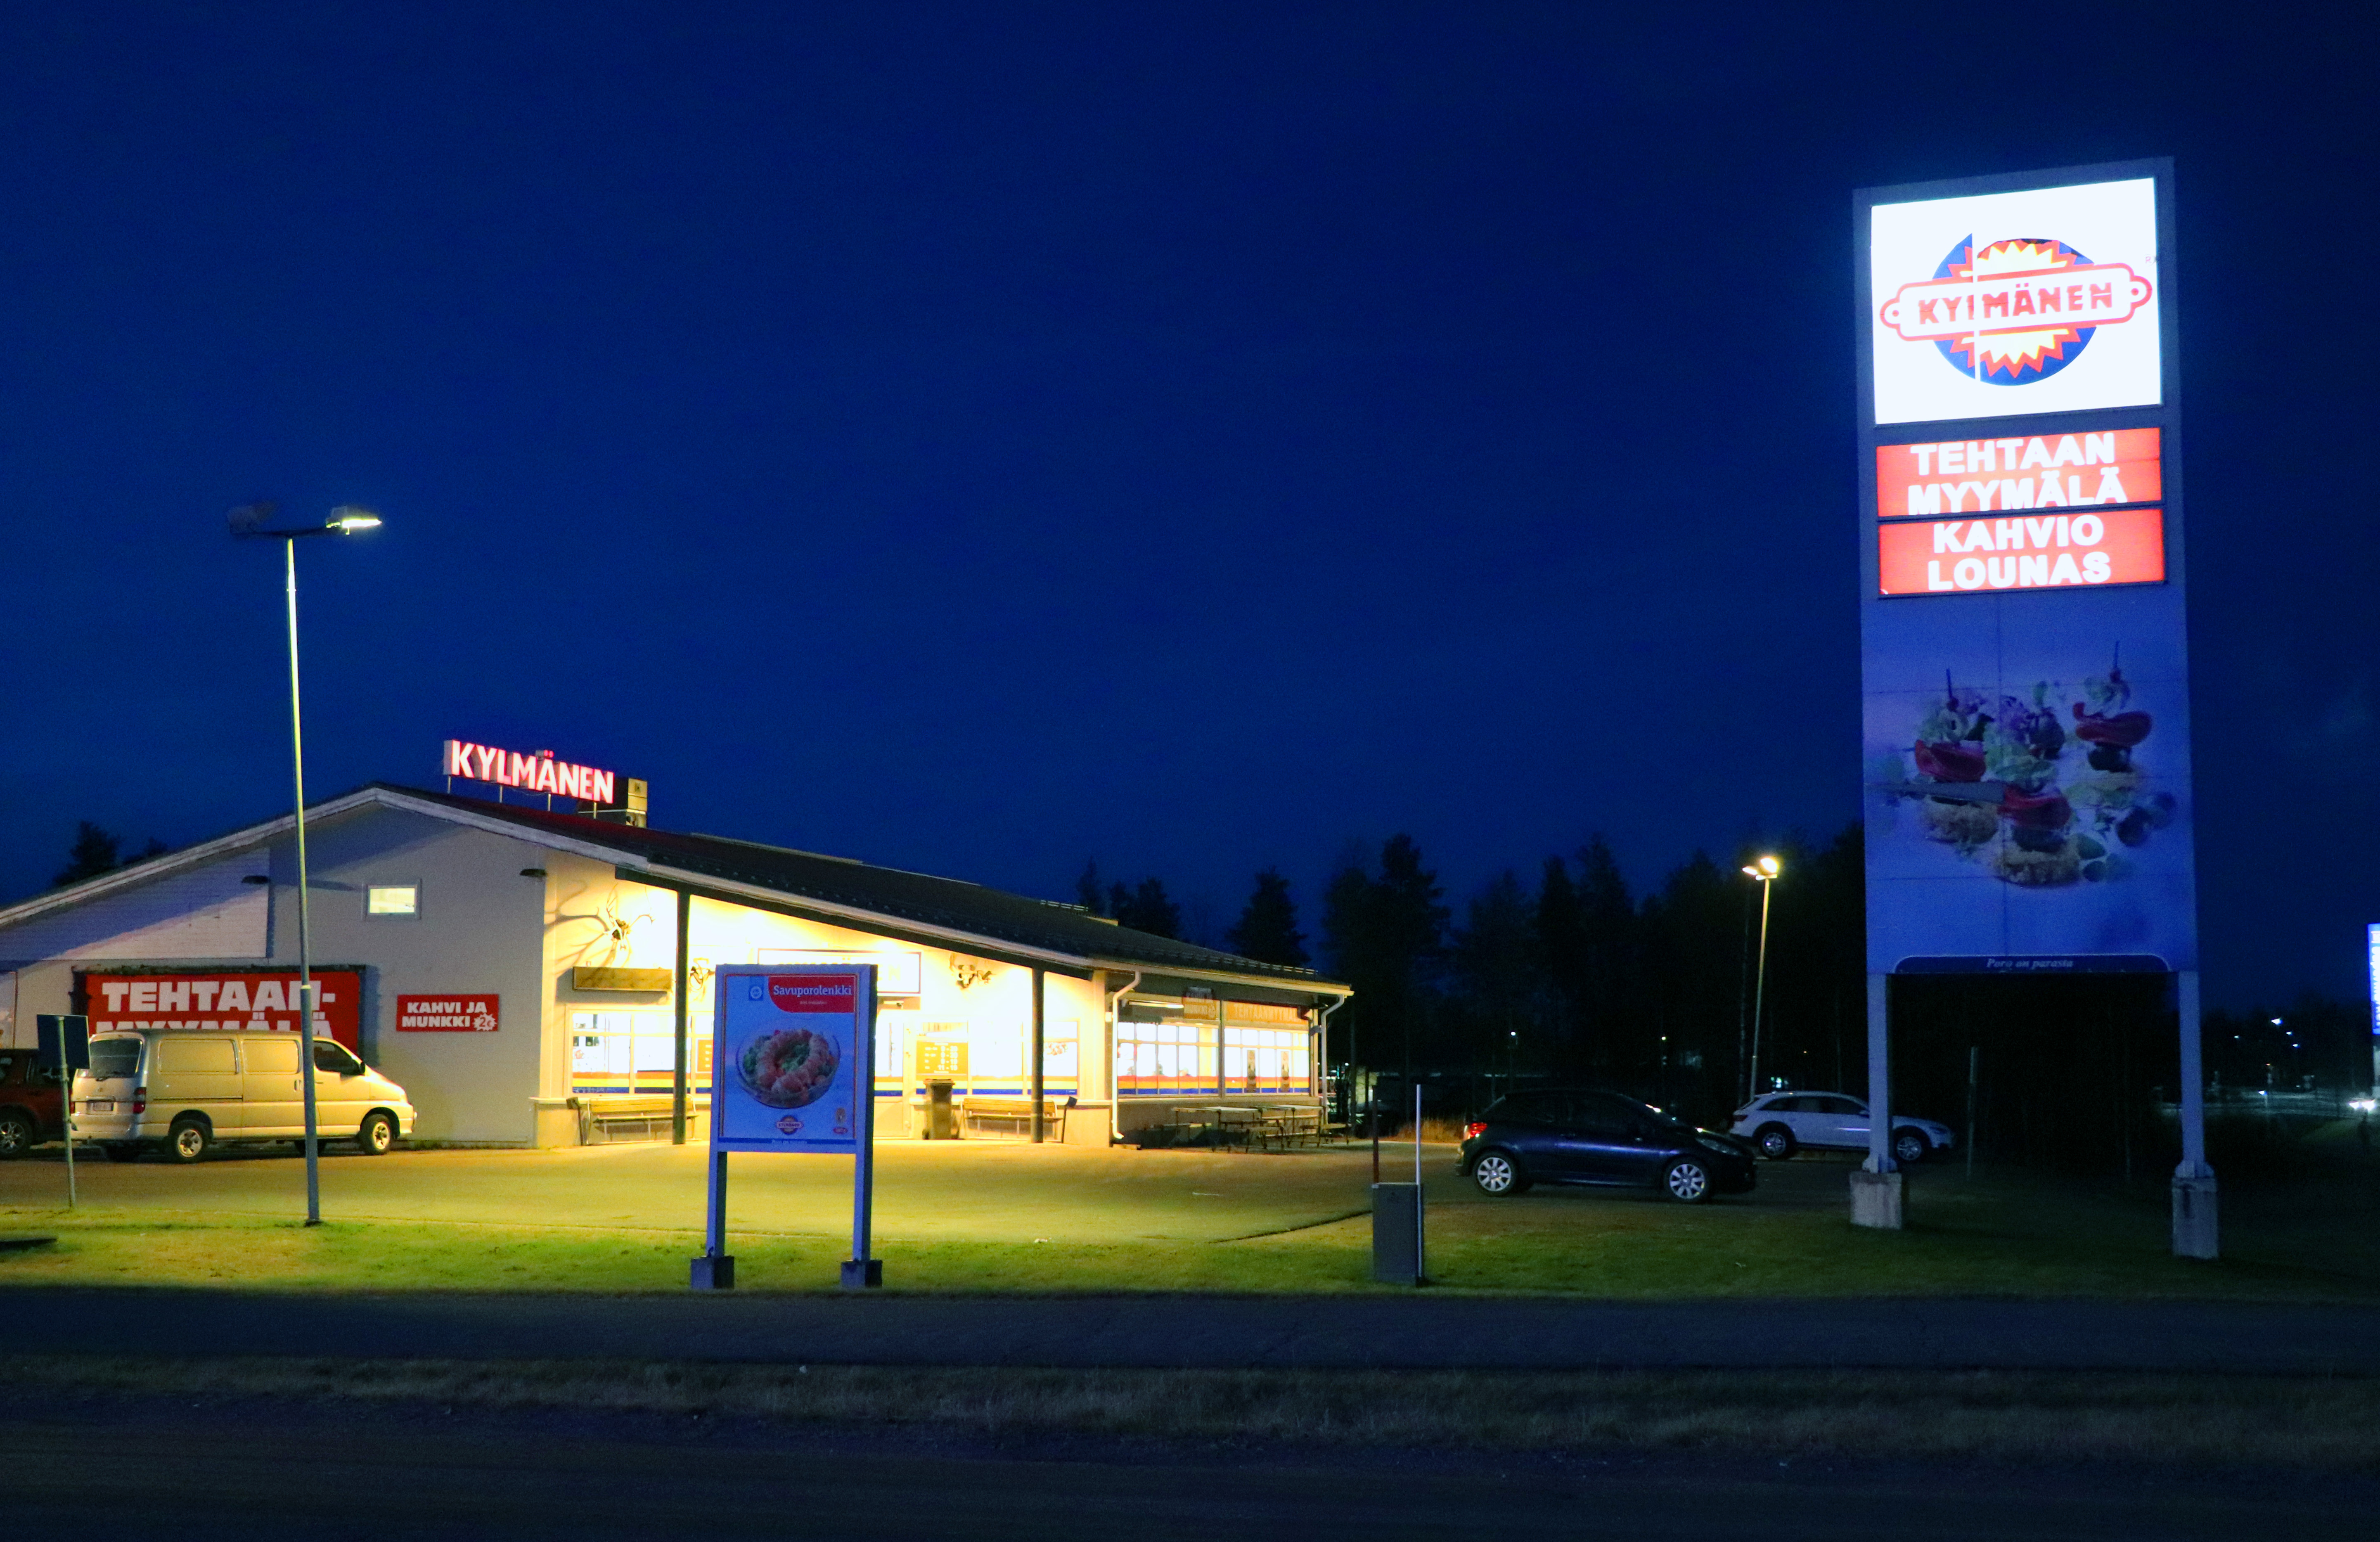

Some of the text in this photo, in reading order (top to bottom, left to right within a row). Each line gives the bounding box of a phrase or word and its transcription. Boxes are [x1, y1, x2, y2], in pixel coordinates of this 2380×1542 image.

[1910, 432, 2115, 476] TEHTAAN
[1908, 467, 2128, 516] MYYMÄLÄ
[1933, 514, 2103, 554] KAHVIO
[1928, 551, 2111, 591] LOUNAS
[451, 739, 614, 804] KYLMÄNEN
[407, 1002, 488, 1014] KAHVI JA
[773, 984, 853, 998] Savuporolenkki
[402, 1016, 471, 1027] MUNKKI
